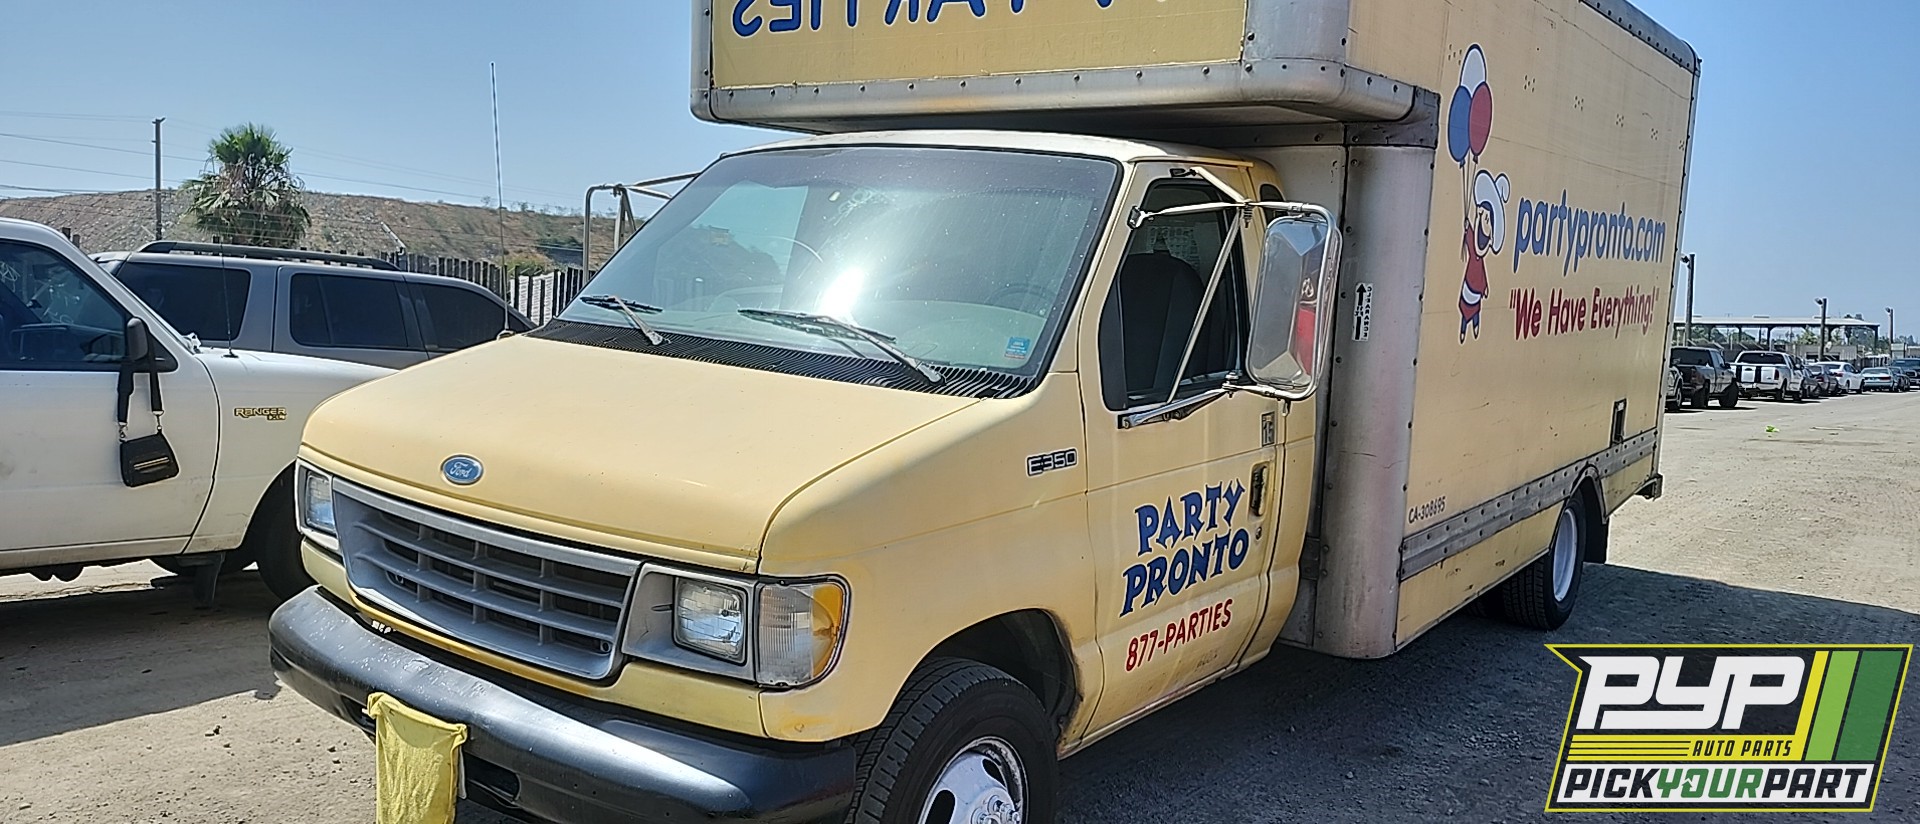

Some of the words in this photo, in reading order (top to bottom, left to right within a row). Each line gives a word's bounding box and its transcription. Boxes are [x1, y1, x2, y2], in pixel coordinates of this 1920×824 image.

[1513, 189, 1666, 277] partypronto.com
[1509, 287, 1542, 340] "We
[1547, 287, 1586, 336] Have
[450, 461, 473, 478] Ford
[1135, 478, 1246, 557] PARTY
[1119, 528, 1249, 618] PRONTO
[1125, 598, 1233, 672] 877-PARTIES
